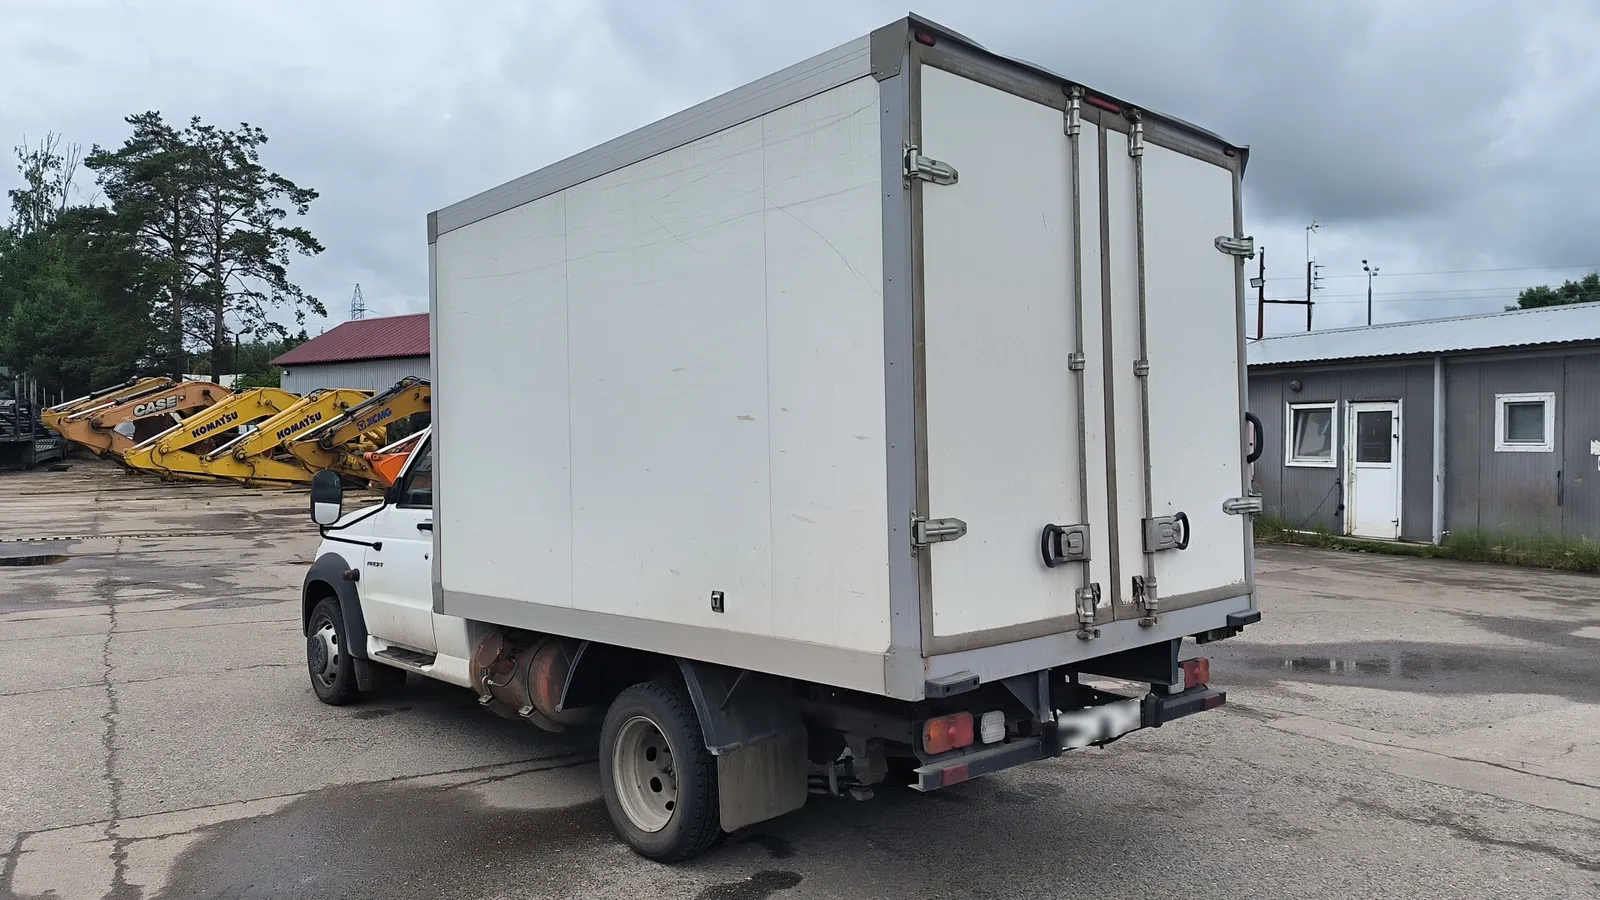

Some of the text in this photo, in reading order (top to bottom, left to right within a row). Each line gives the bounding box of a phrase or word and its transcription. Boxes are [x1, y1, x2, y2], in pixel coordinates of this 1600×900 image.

[133, 395, 177, 417] CASE
[366, 408, 393, 427] XCMG
[192, 411, 239, 439] KOMATSU
[276, 412, 322, 440] KOMATSU
